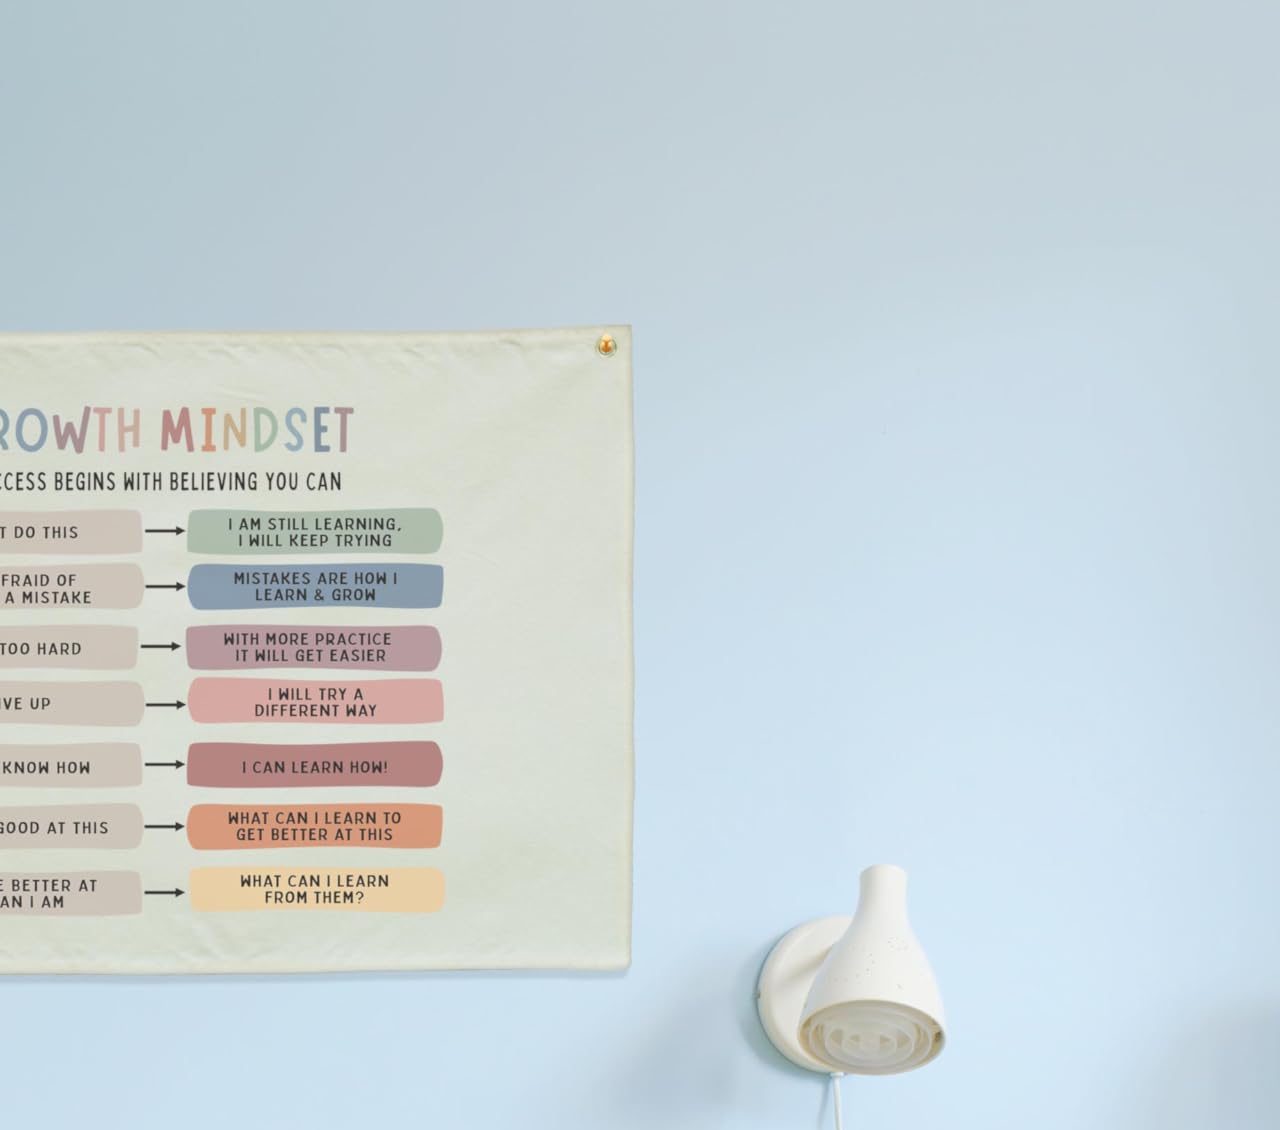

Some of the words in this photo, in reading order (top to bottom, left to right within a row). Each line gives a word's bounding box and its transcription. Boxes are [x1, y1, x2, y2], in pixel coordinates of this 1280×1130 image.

[160, 406, 355, 453] MINDSET
[54, 471, 116, 491] BEGINS
[123, 471, 162, 491] WITH
[169, 471, 257, 491] BELIEVING
[265, 471, 298, 491] YOU
[306, 471, 341, 491] CAN
[228, 518, 232, 531] I
[238, 517, 261, 531] AM
[268, 517, 308, 531] STILL
[14, 525, 36, 539] DO
[42, 526, 78, 539] THIS
[239, 534, 243, 547] I
[249, 534, 282, 547] WILL
[289, 533, 329, 547] KEEP
[335, 534, 392, 547] TRYING
[56, 574, 76, 587] OF
[234, 571, 311, 585] MISTAKES
[317, 571, 348, 585] ARE
[354, 571, 387, 585] HOW
[393, 572, 397, 585] I
[4, 591, 15, 604] A
[22, 591, 91, 604] MISTAKE
[255, 588, 307, 601] LEARN
[313, 588, 325, 601] &
[331, 588, 376, 601] GROW
[223, 632, 259, 646] WITH
[265, 632, 309, 646] MORE
[315, 632, 391, 646] PRACTICE
[0, 642, 30, 656] TOO
[37, 642, 82, 656] HARD
[235, 649, 249, 662] IT
[255, 648, 289, 662] WILL
[295, 648, 323, 662] GET
[329, 648, 386, 662] EASIER
[268, 687, 272, 701] I
[278, 687, 312, 701] WILL
[319, 687, 347, 701] TRY
[353, 687, 364, 701] A
[30, 697, 51, 710] UP
[254, 704, 340, 717] DIFFERENT
[346, 703, 377, 717] WAY
[2, 761, 49, 775] KNOW
[56, 761, 90, 774] HOW
[242, 761, 246, 774] I
[252, 760, 285, 774] CAN
[291, 760, 344, 774] LEARN
[350, 760, 388, 774] HOW!
[228, 811, 269, 825] WHAT
[275, 811, 308, 825] CAN
[314, 811, 318, 825] I
[324, 811, 377, 825] LEARN
[383, 811, 402, 825] TO
[47, 821, 66, 835] AT
[73, 821, 109, 835] THIS
[236, 827, 265, 841] GET
[271, 827, 328, 841] BETTER
[334, 828, 353, 841] AT
[359, 828, 393, 841] THIS
[11, 879, 71, 892] BETTER
[78, 879, 97, 892] AT
[240, 874, 281, 888] WHAT
[287, 874, 320, 888] CAN
[327, 874, 331, 888] I
[337, 874, 389, 888] LEARN
[30, 895, 34, 908] I
[41, 895, 64, 909] AM
[265, 890, 308, 904] FROM
[313, 890, 364, 904] THEM?
